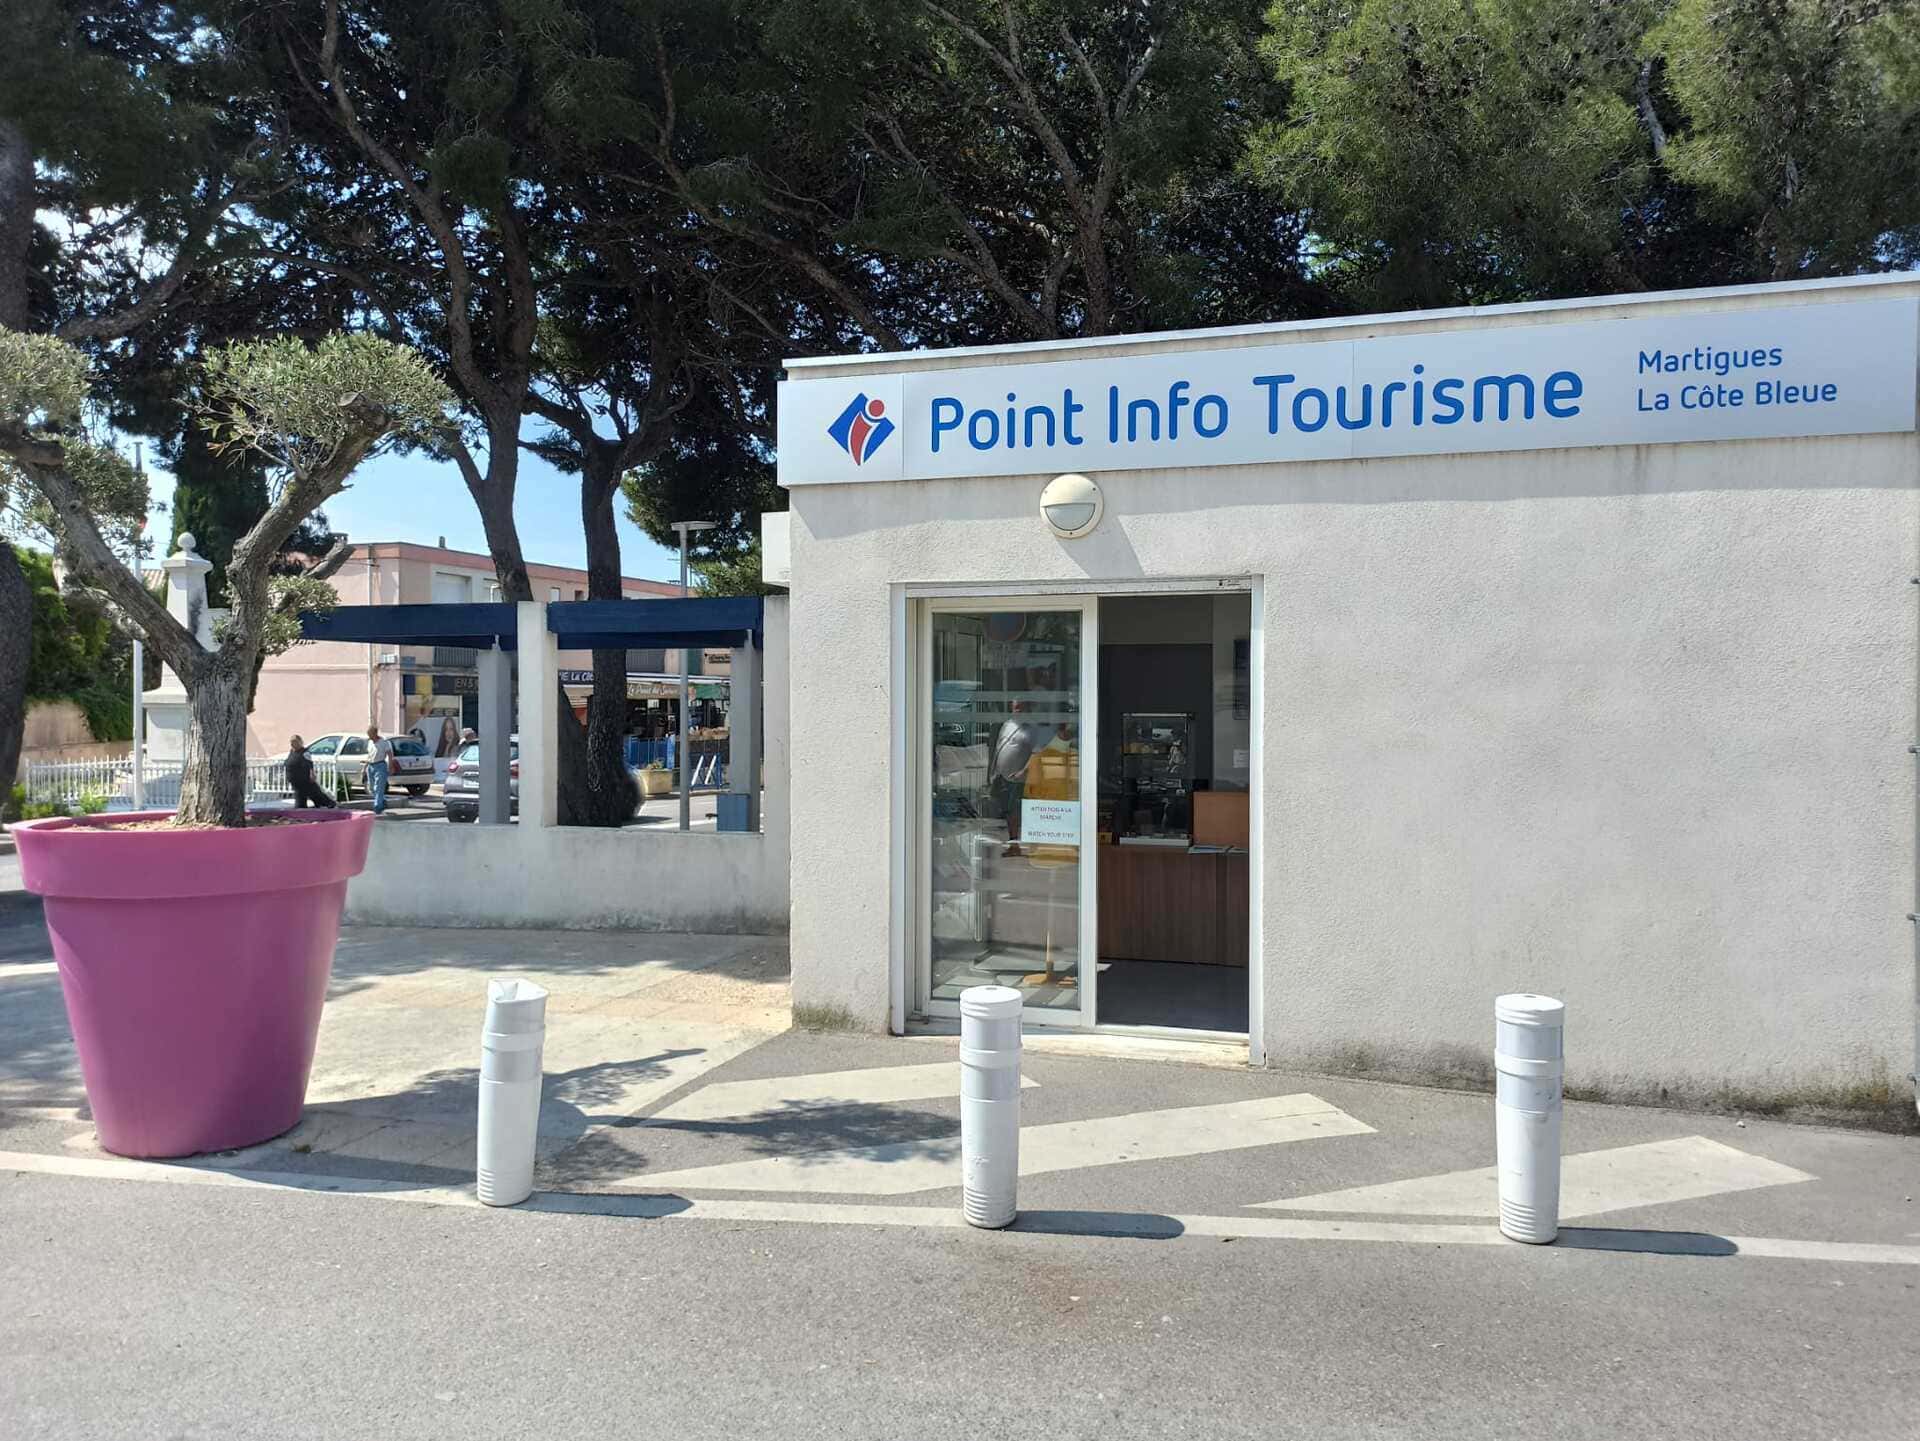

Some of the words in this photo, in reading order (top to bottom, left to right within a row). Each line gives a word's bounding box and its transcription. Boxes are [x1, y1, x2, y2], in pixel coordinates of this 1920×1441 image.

[1637, 346, 1784, 379] Martigues
[930, 387, 1086, 454] Point
[1107, 379, 1231, 446] Info
[1251, 363, 1585, 436] Tourisme
[1637, 390, 1671, 412] La
[1679, 383, 1745, 411] Côte
[1755, 379, 1838, 407] Bleue
